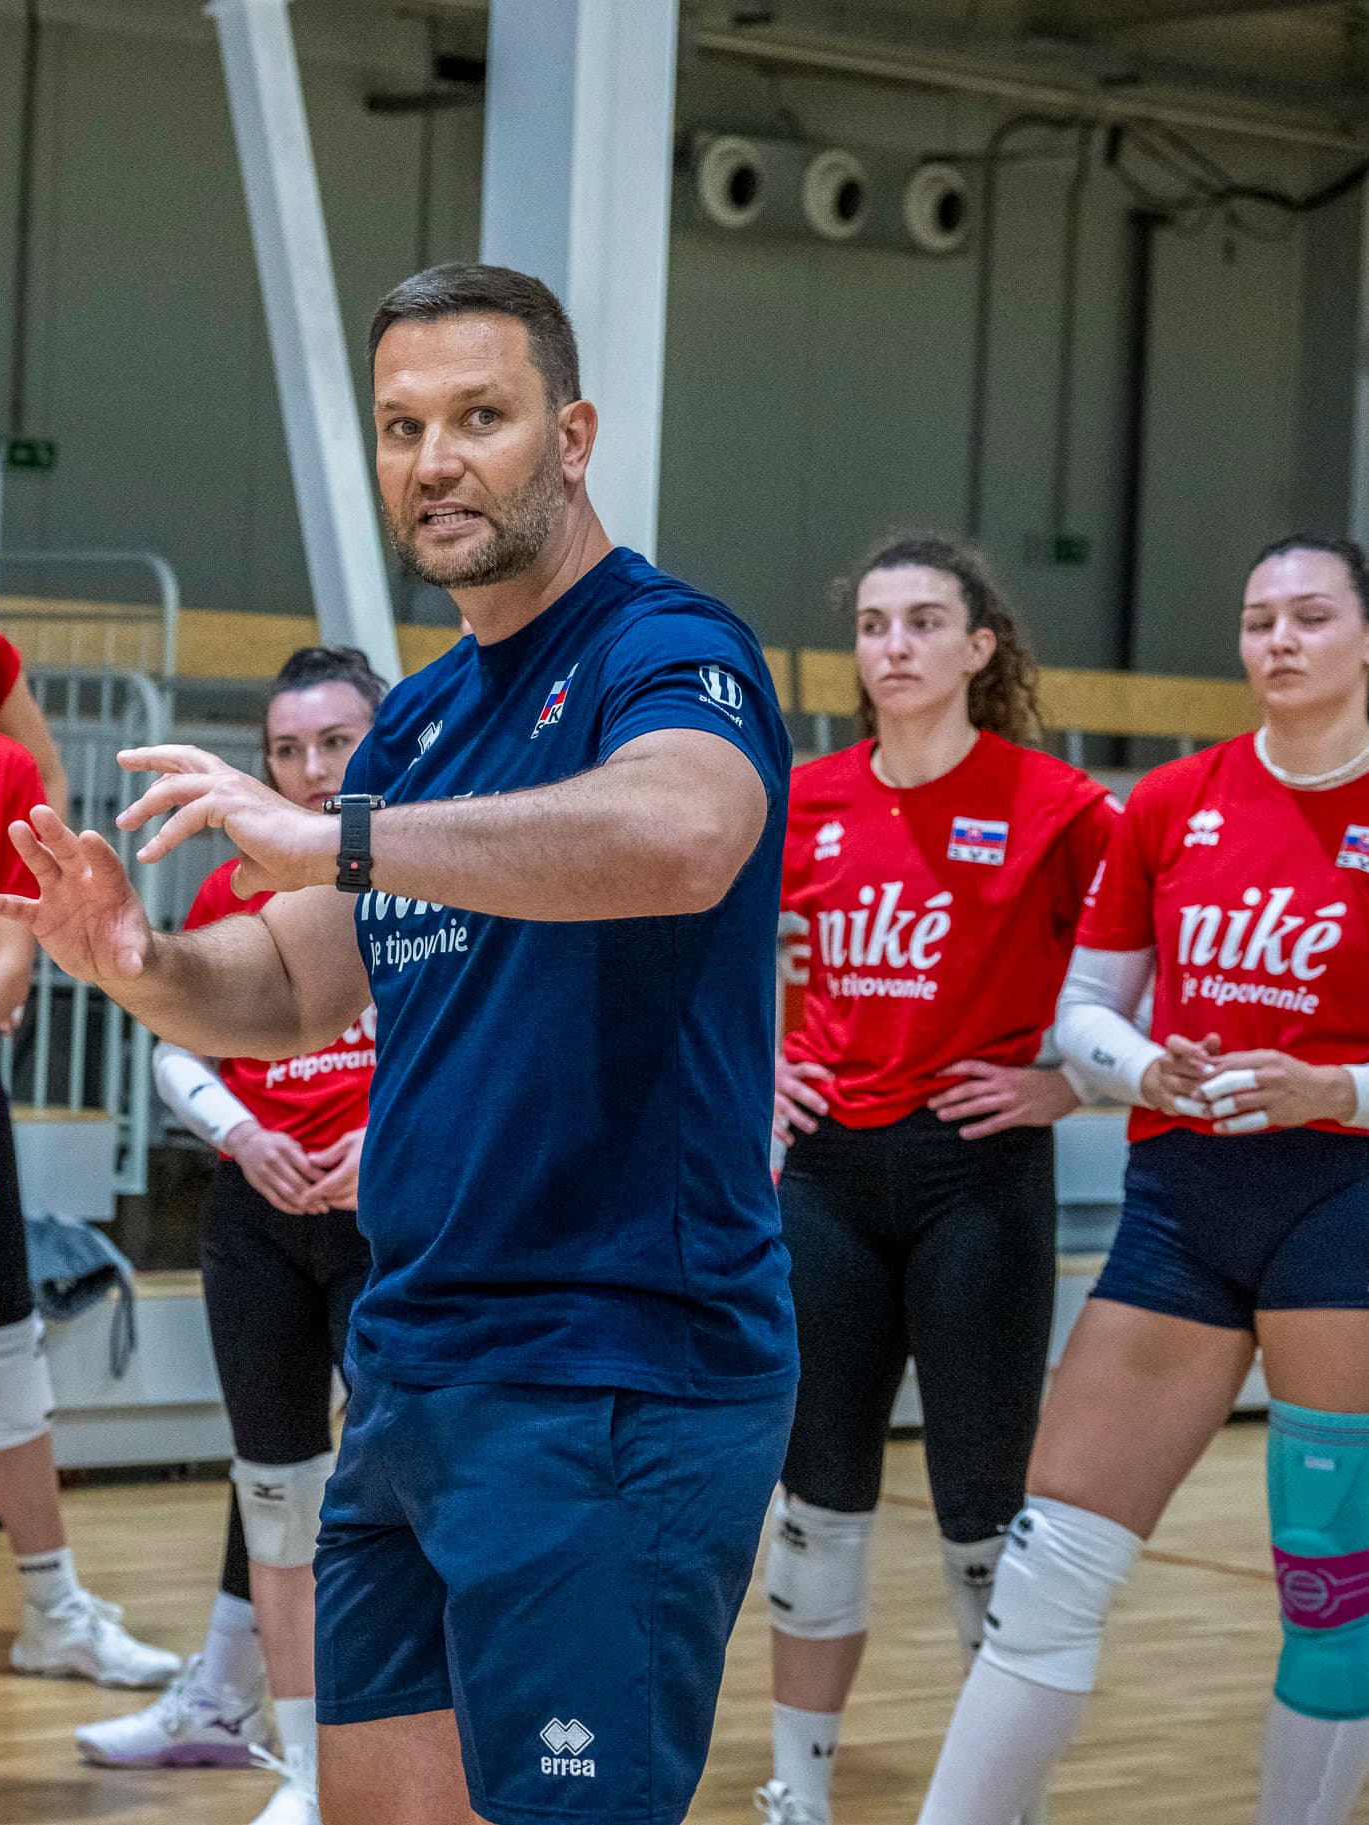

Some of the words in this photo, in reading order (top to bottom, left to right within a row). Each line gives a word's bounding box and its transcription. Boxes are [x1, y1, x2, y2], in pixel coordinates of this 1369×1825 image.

[817, 880, 954, 970] niké
[1177, 886, 1348, 981] niké
[369, 933, 381, 977] je
[1199, 973, 1320, 1015] tipovanie
[540, 1755, 596, 1778] errea
